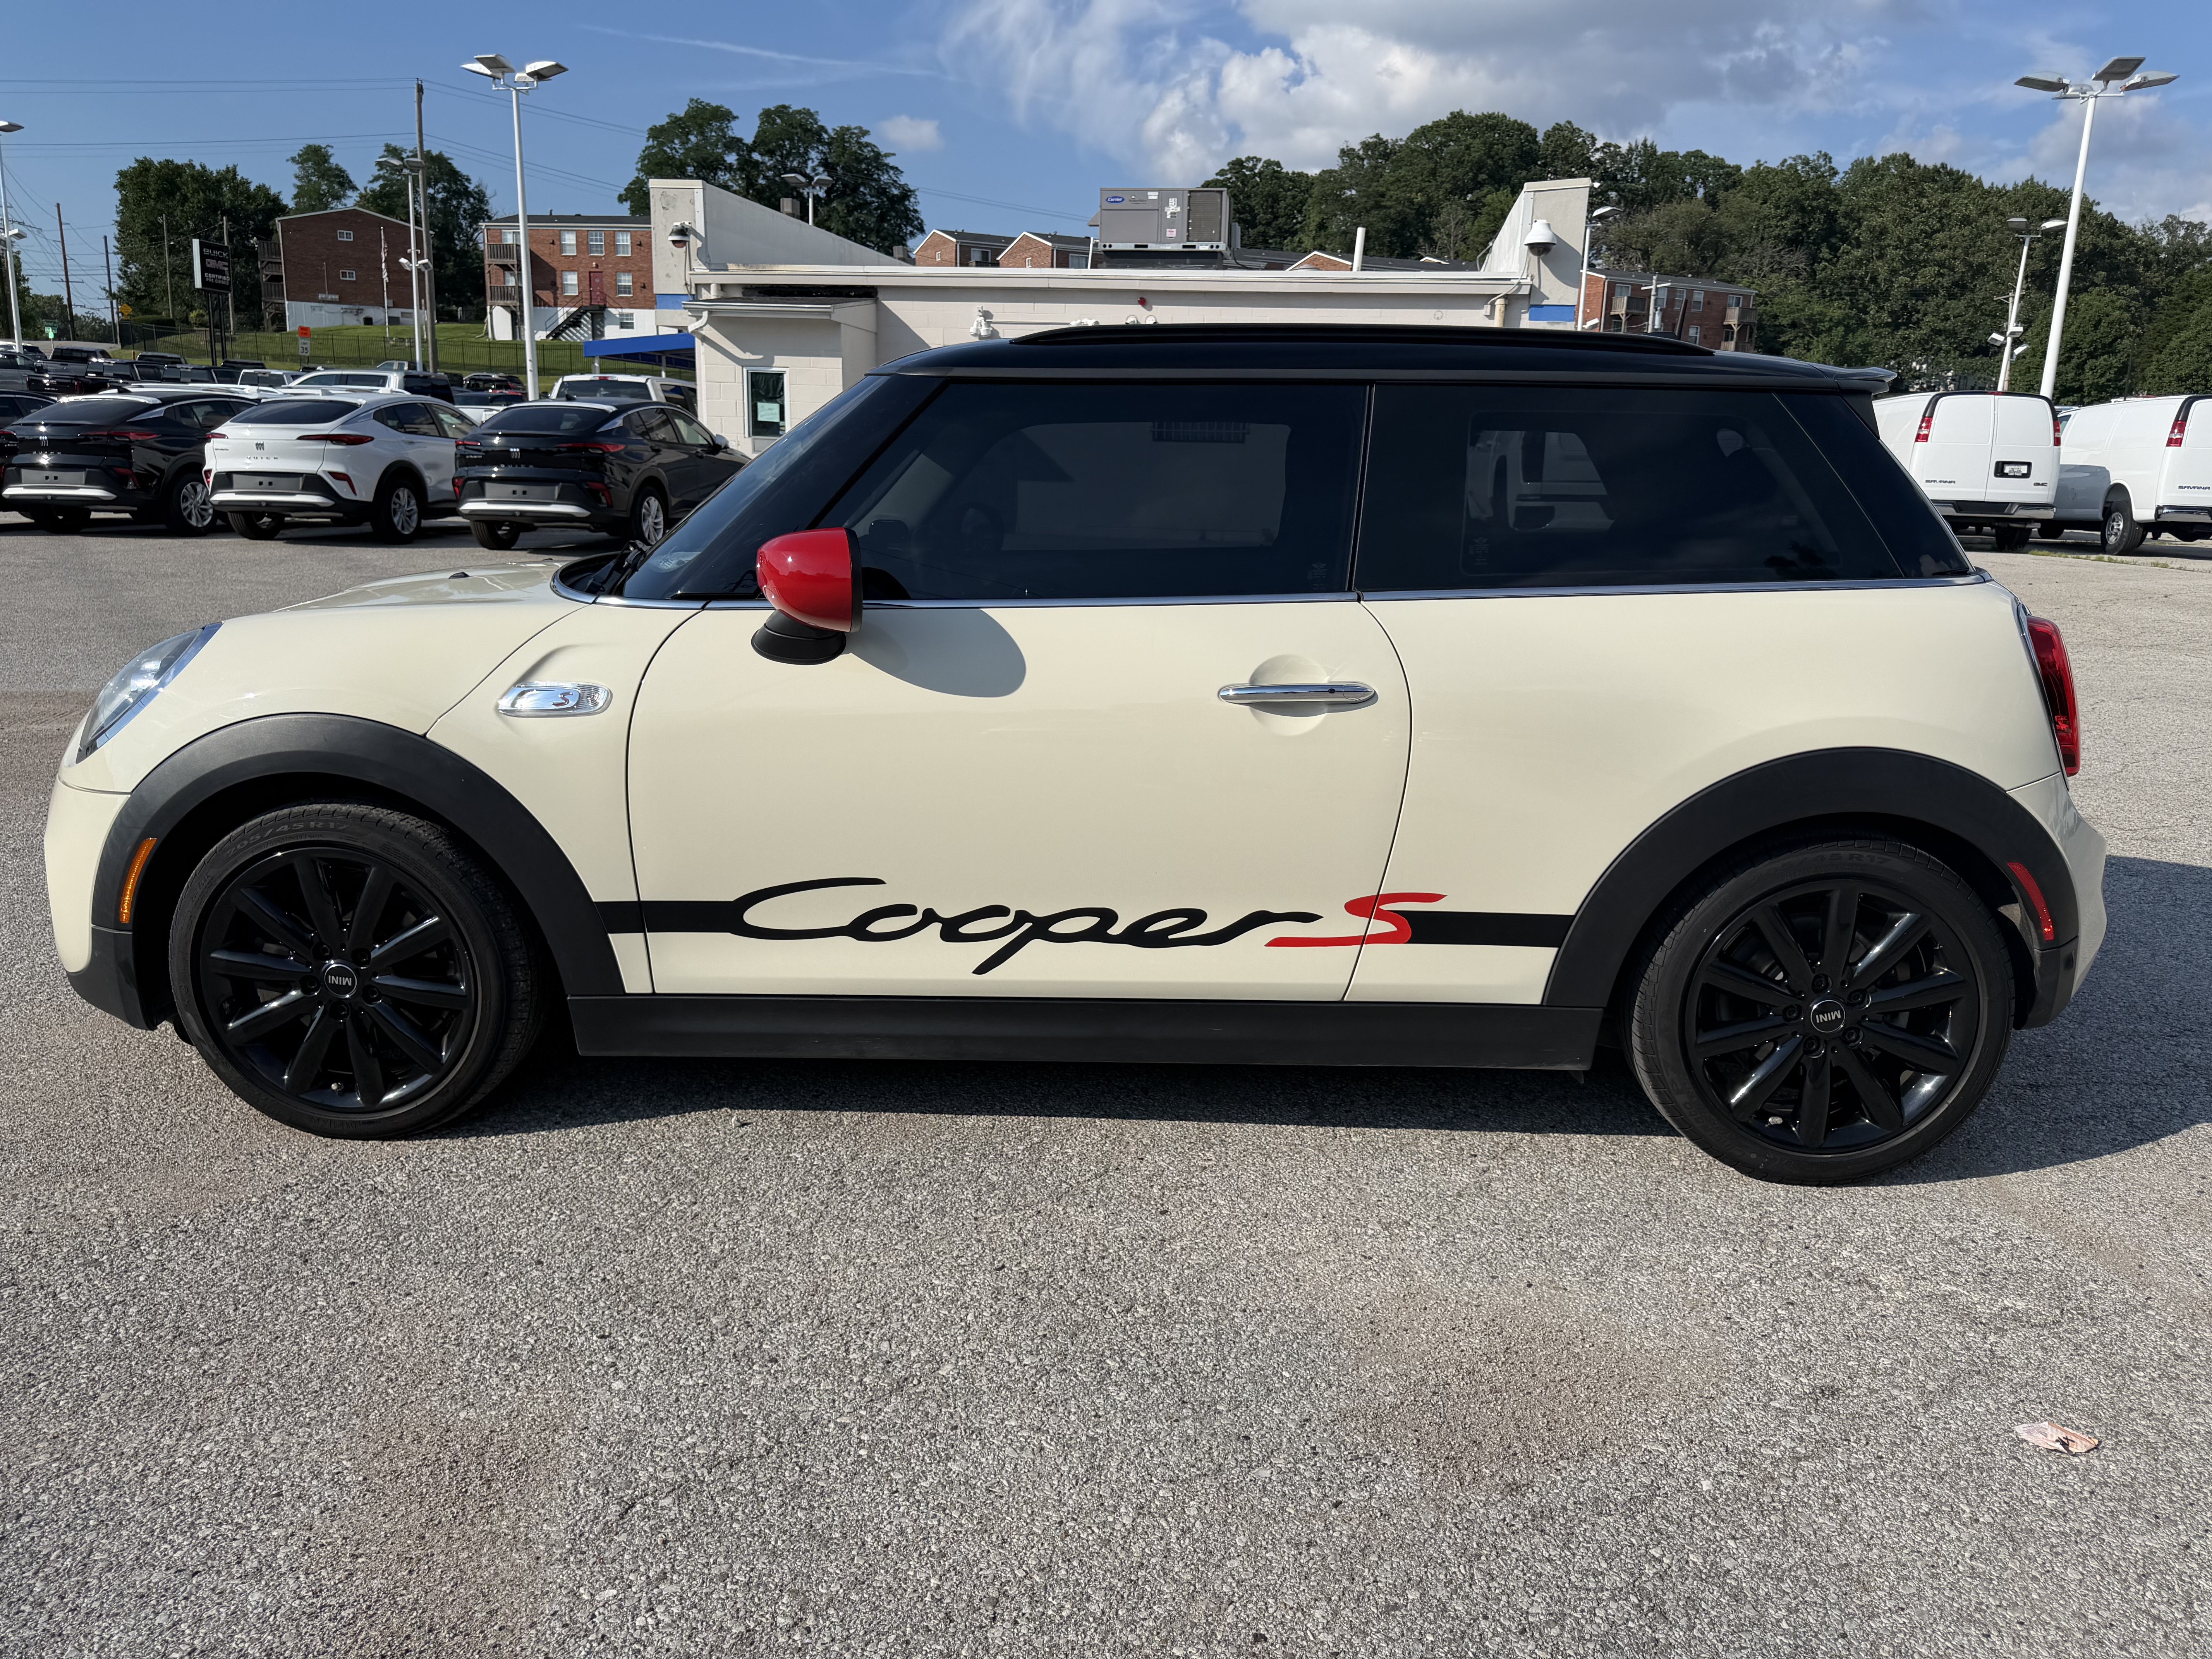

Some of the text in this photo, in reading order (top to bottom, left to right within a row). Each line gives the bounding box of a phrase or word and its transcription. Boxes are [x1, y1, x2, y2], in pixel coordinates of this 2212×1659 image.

[203, 248, 229, 259] BUICK
[206, 258, 229, 271] GMC
[204, 273, 230, 281] CERTIFIED
[552, 692, 573, 707] S
[227, 822, 304, 857] 205/45
[309, 821, 351, 830] R17
[730, 877, 1448, 975] Cooper S
[328, 975, 352, 986] MINI
[1816, 1010, 1841, 1023] MINI
